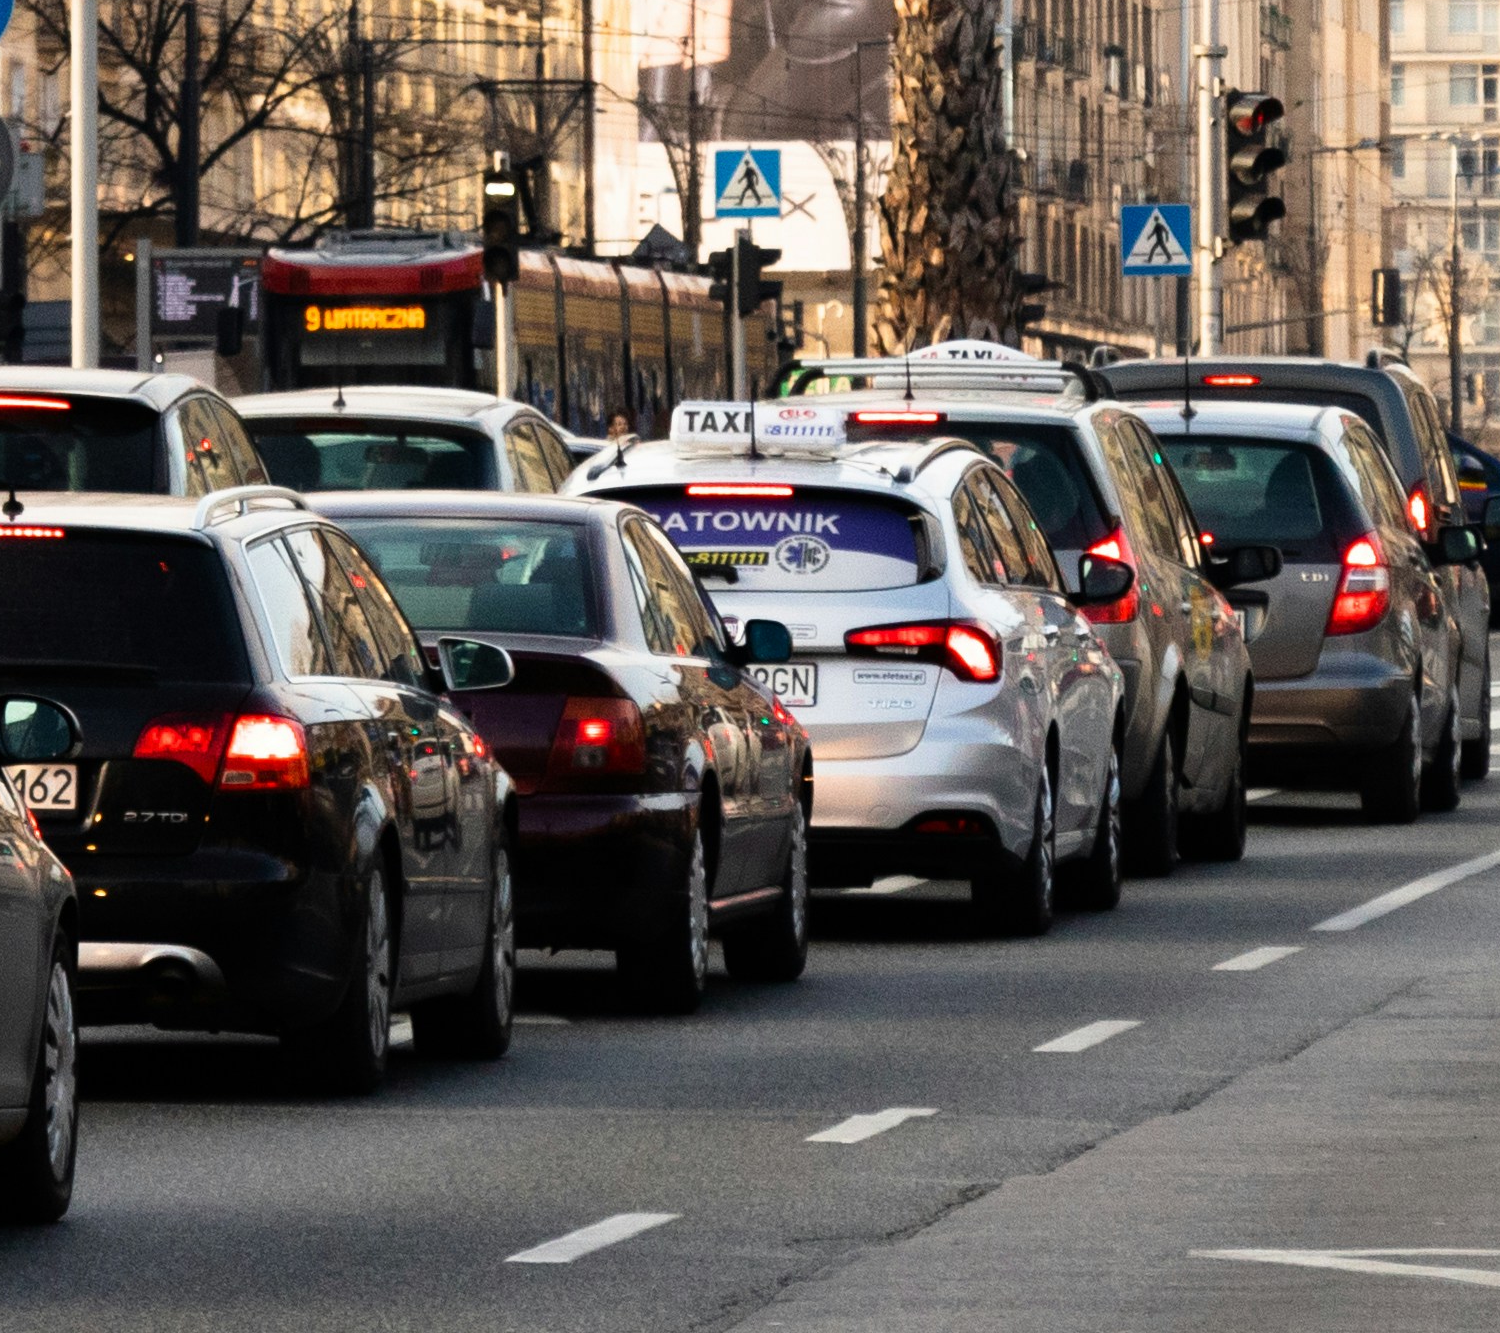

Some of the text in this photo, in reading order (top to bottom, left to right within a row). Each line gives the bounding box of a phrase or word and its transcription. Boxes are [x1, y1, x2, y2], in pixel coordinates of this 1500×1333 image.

[304, 304, 321, 332] 9
[684, 411, 752, 434] TAXI
[867, 698, 916, 710] TIPO
[11, 768, 73, 805] 462
